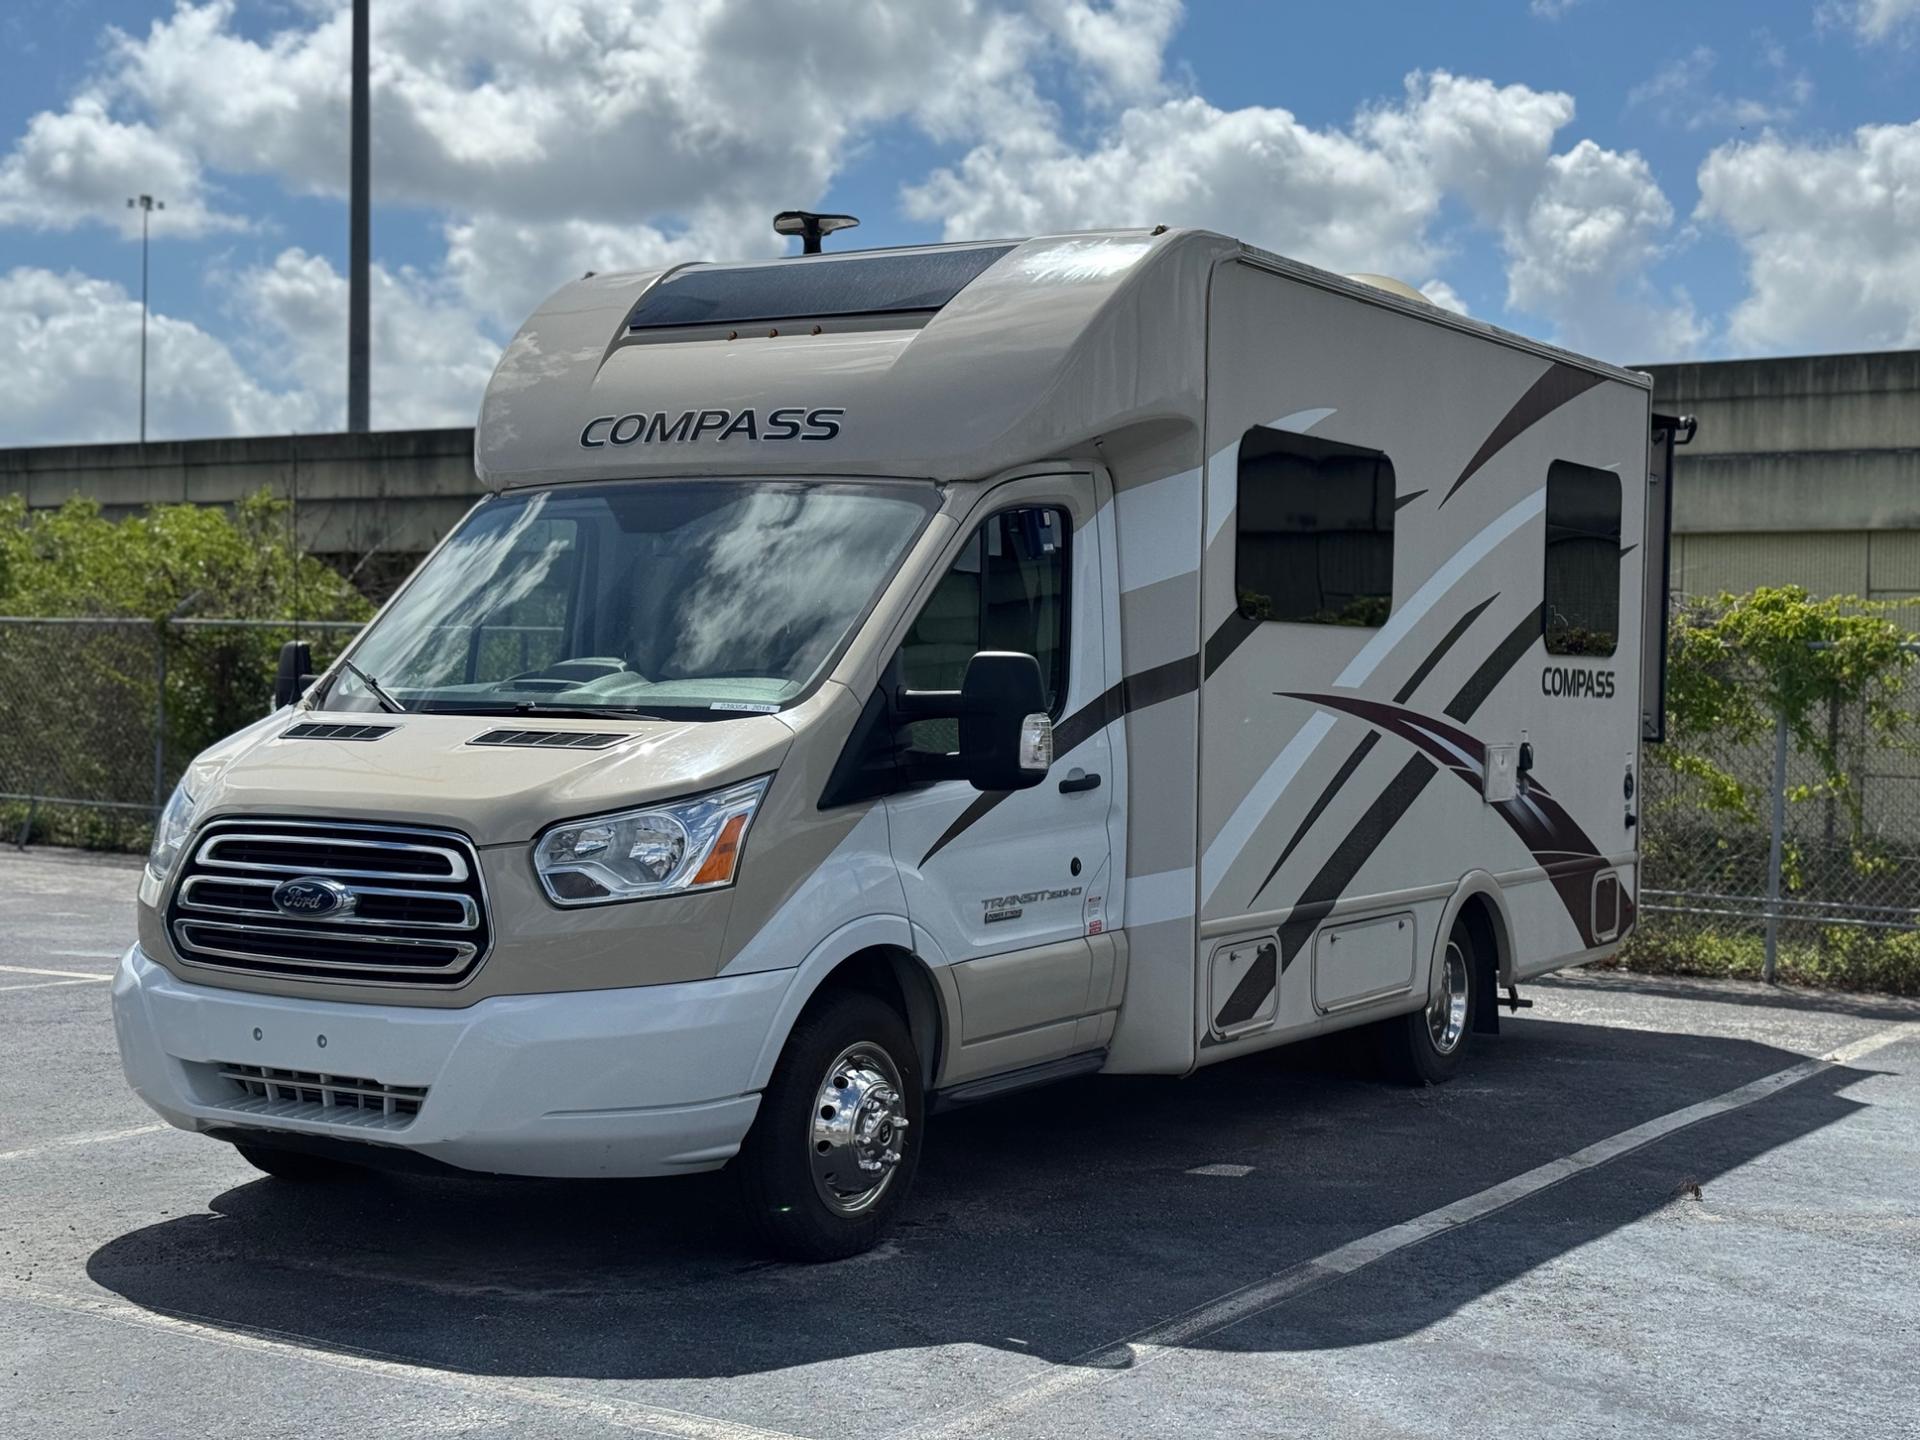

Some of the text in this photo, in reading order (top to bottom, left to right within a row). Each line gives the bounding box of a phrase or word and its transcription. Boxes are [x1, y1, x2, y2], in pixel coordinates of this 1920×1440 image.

[580, 407, 846, 449] COMPASS
[1541, 666, 1615, 699] COMPASS
[283, 885, 322, 909] Ford
[981, 889, 1048, 910] TRANSIT
